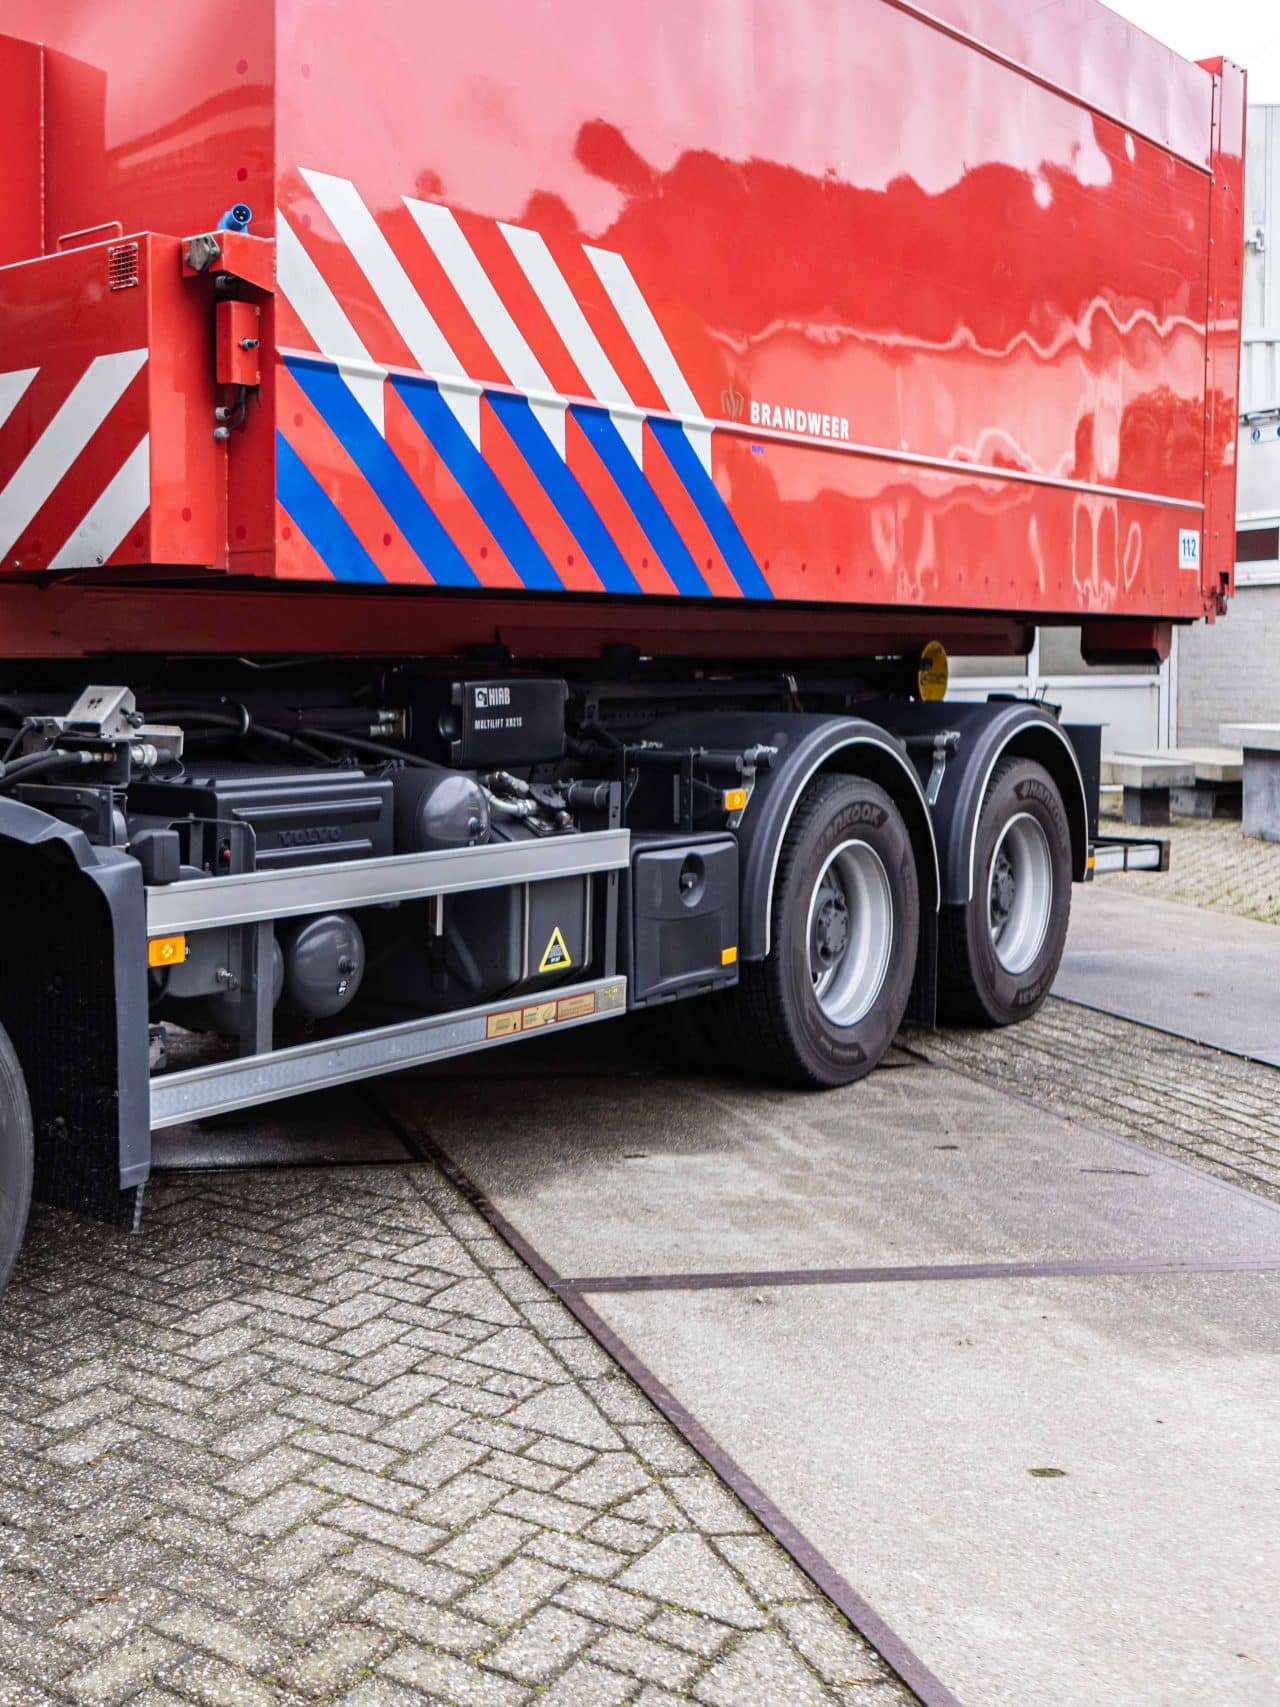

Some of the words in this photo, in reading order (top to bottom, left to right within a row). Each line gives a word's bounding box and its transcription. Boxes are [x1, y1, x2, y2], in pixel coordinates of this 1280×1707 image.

[750, 400, 849, 440] BRANDWEER
[1182, 537, 1197, 557] 112
[488, 687, 511, 706] HIAB
[474, 718, 504, 730] MULTILIFT
